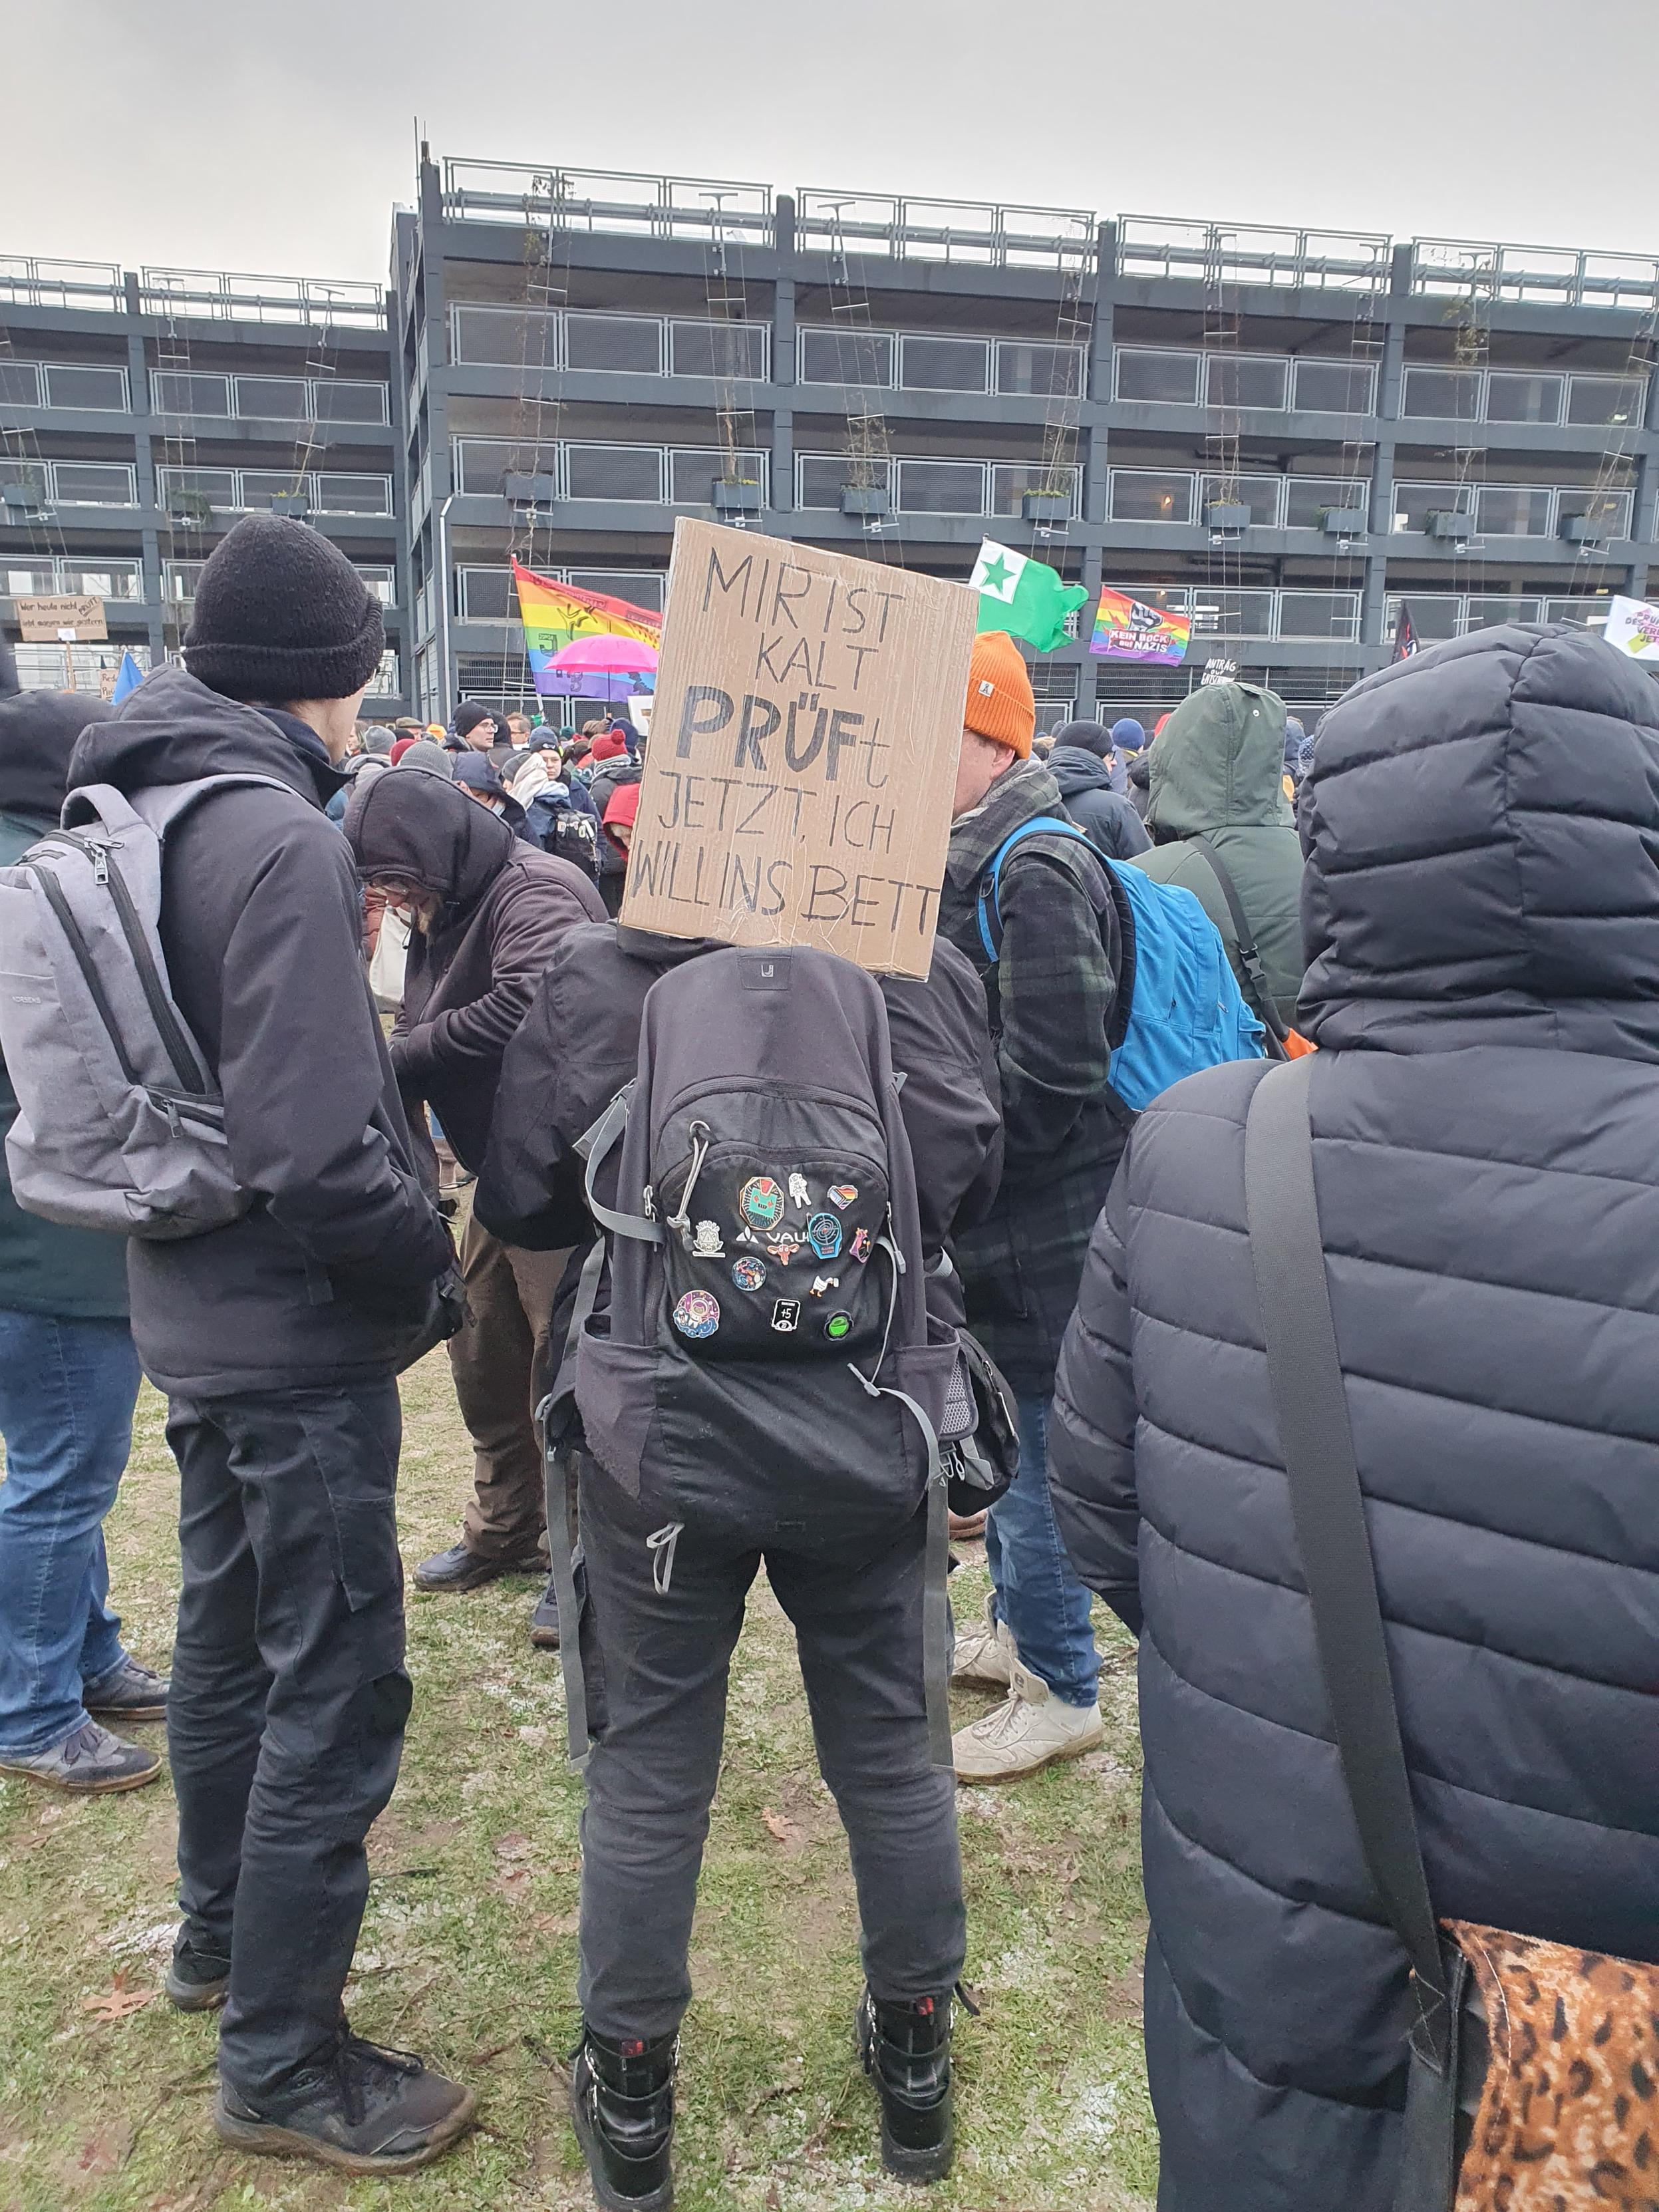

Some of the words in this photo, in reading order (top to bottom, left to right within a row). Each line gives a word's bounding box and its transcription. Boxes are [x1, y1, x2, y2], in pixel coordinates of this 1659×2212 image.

[702, 547, 813, 629] MIR
[823, 577, 907, 643] IST
[1110, 630, 1136, 641] KEIN
[1139, 633, 1169, 644] BOCK
[1134, 641, 1167, 653] NAZIS
[755, 633, 879, 691] KALT
[1205, 658, 1237, 672] ANTRAG
[829, 795, 895, 854] ICH
[630, 840, 710, 906] WILL
[718, 852, 793, 917] INS
[800, 864, 941, 935] BETT
[781, 1308, 792, 1319] +5
